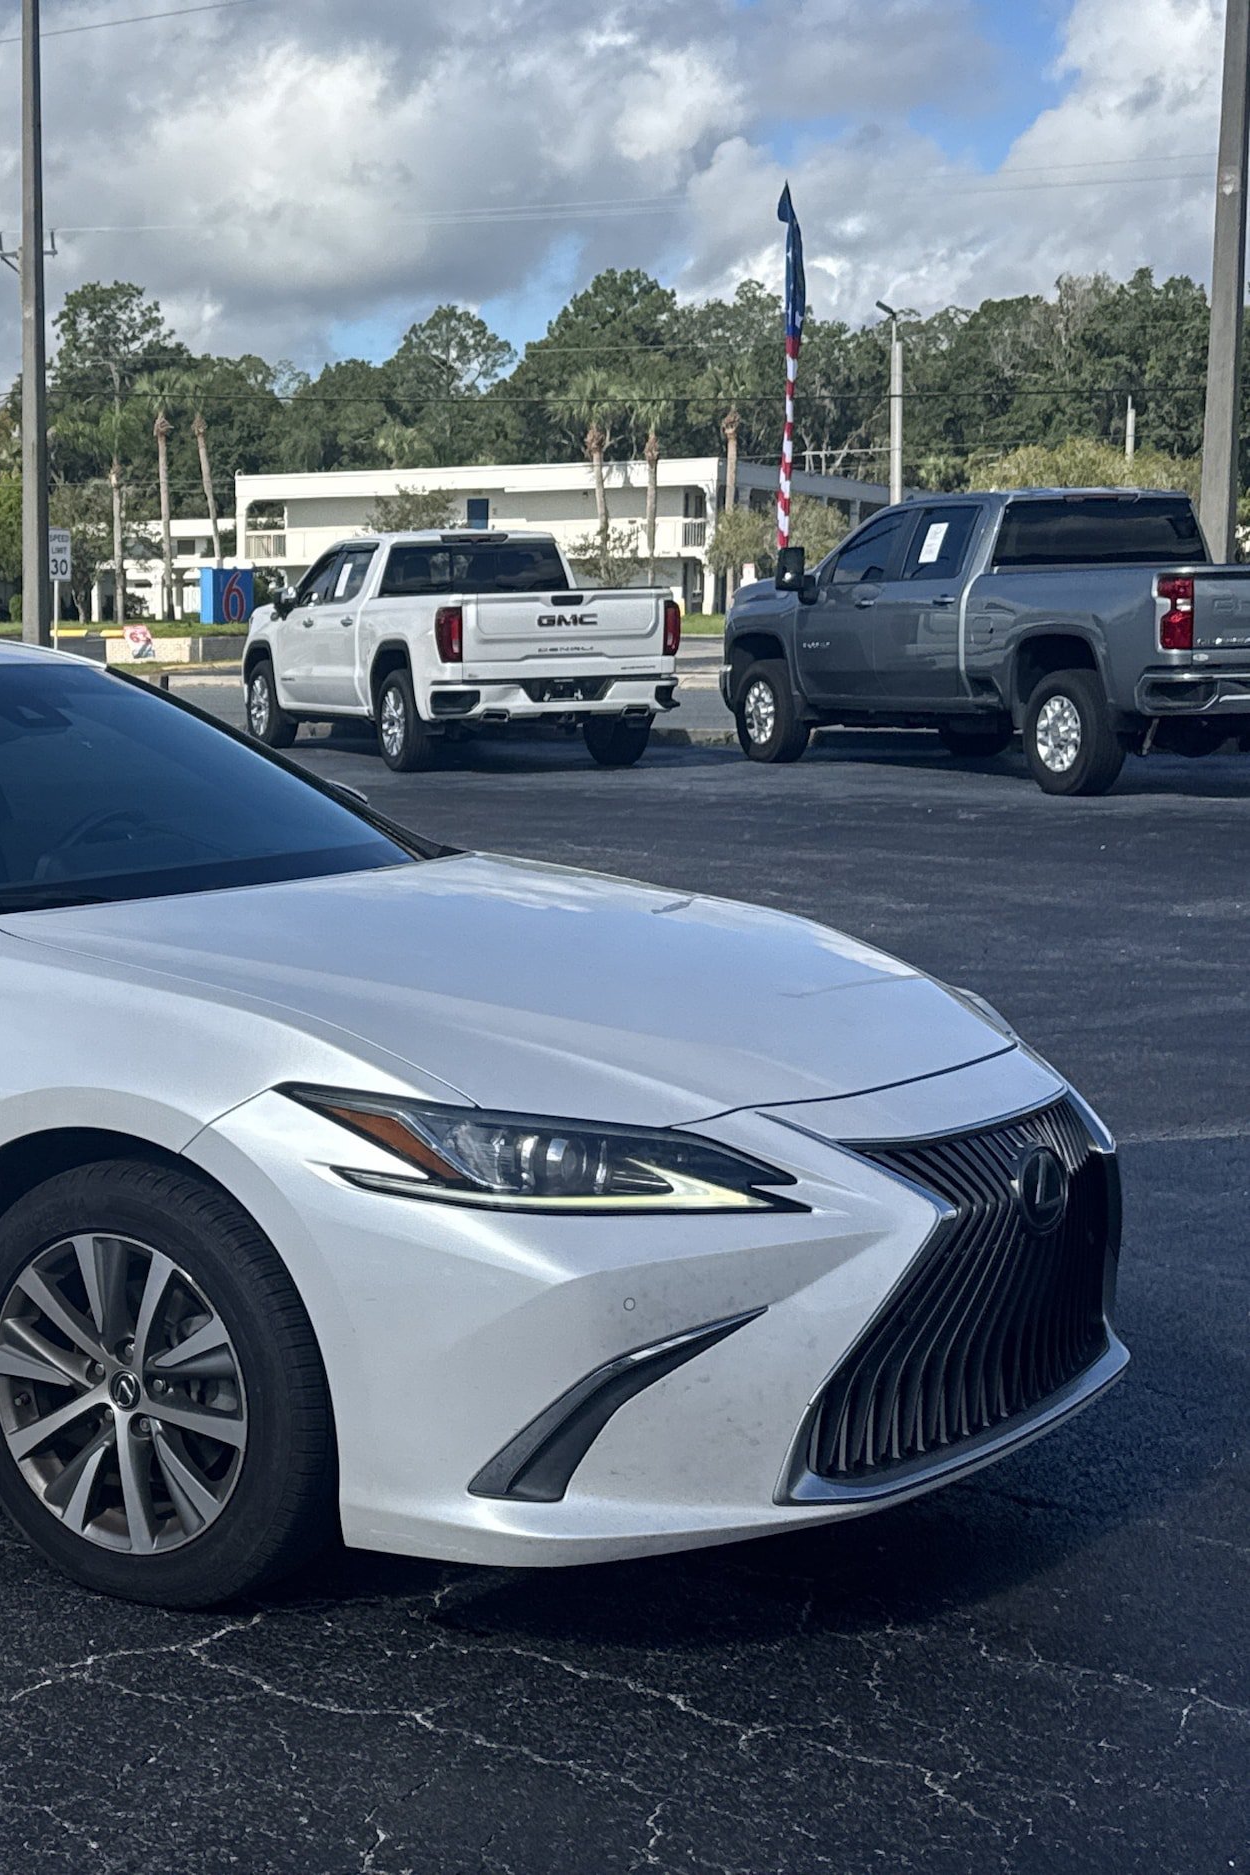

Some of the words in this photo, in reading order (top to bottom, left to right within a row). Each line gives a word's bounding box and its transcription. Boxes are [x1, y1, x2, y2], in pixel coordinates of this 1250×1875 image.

[49, 534, 69, 542] SPEED
[52, 546, 68, 554] LIMIT
[51, 559, 68, 575] 30
[222, 571, 246, 622] 6
[537, 614, 598, 627] GMC
